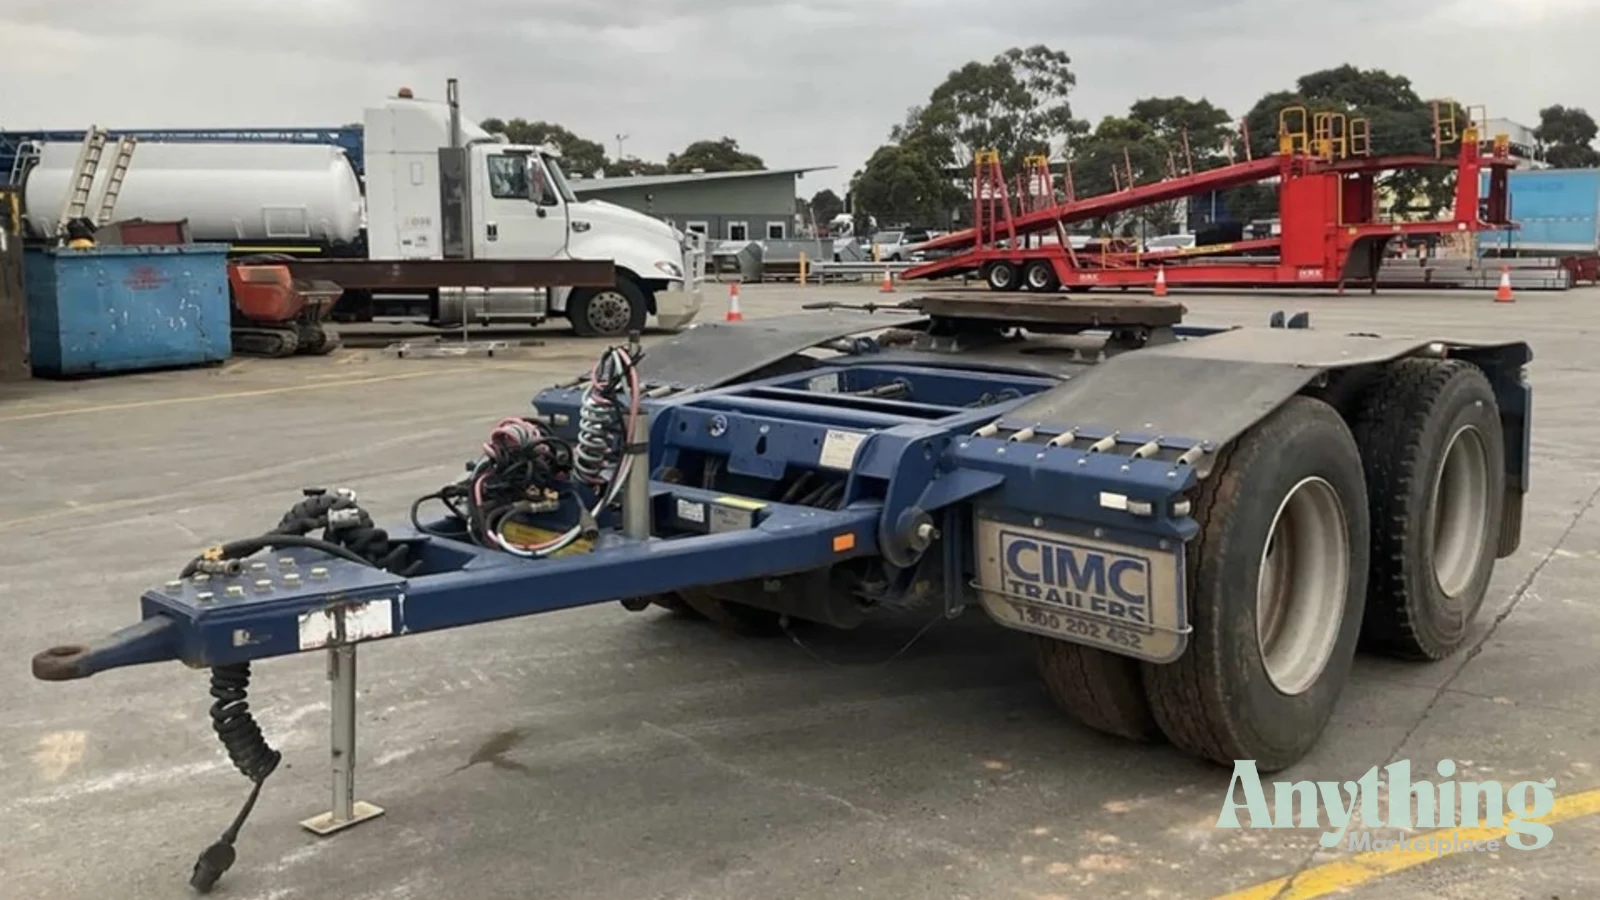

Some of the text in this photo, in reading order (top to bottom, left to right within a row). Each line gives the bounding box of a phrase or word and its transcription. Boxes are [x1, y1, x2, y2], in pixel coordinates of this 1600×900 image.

[1006, 539, 1146, 605] CIMC
[1015, 605, 1060, 629] 1300
[1065, 618, 1101, 639] 202
